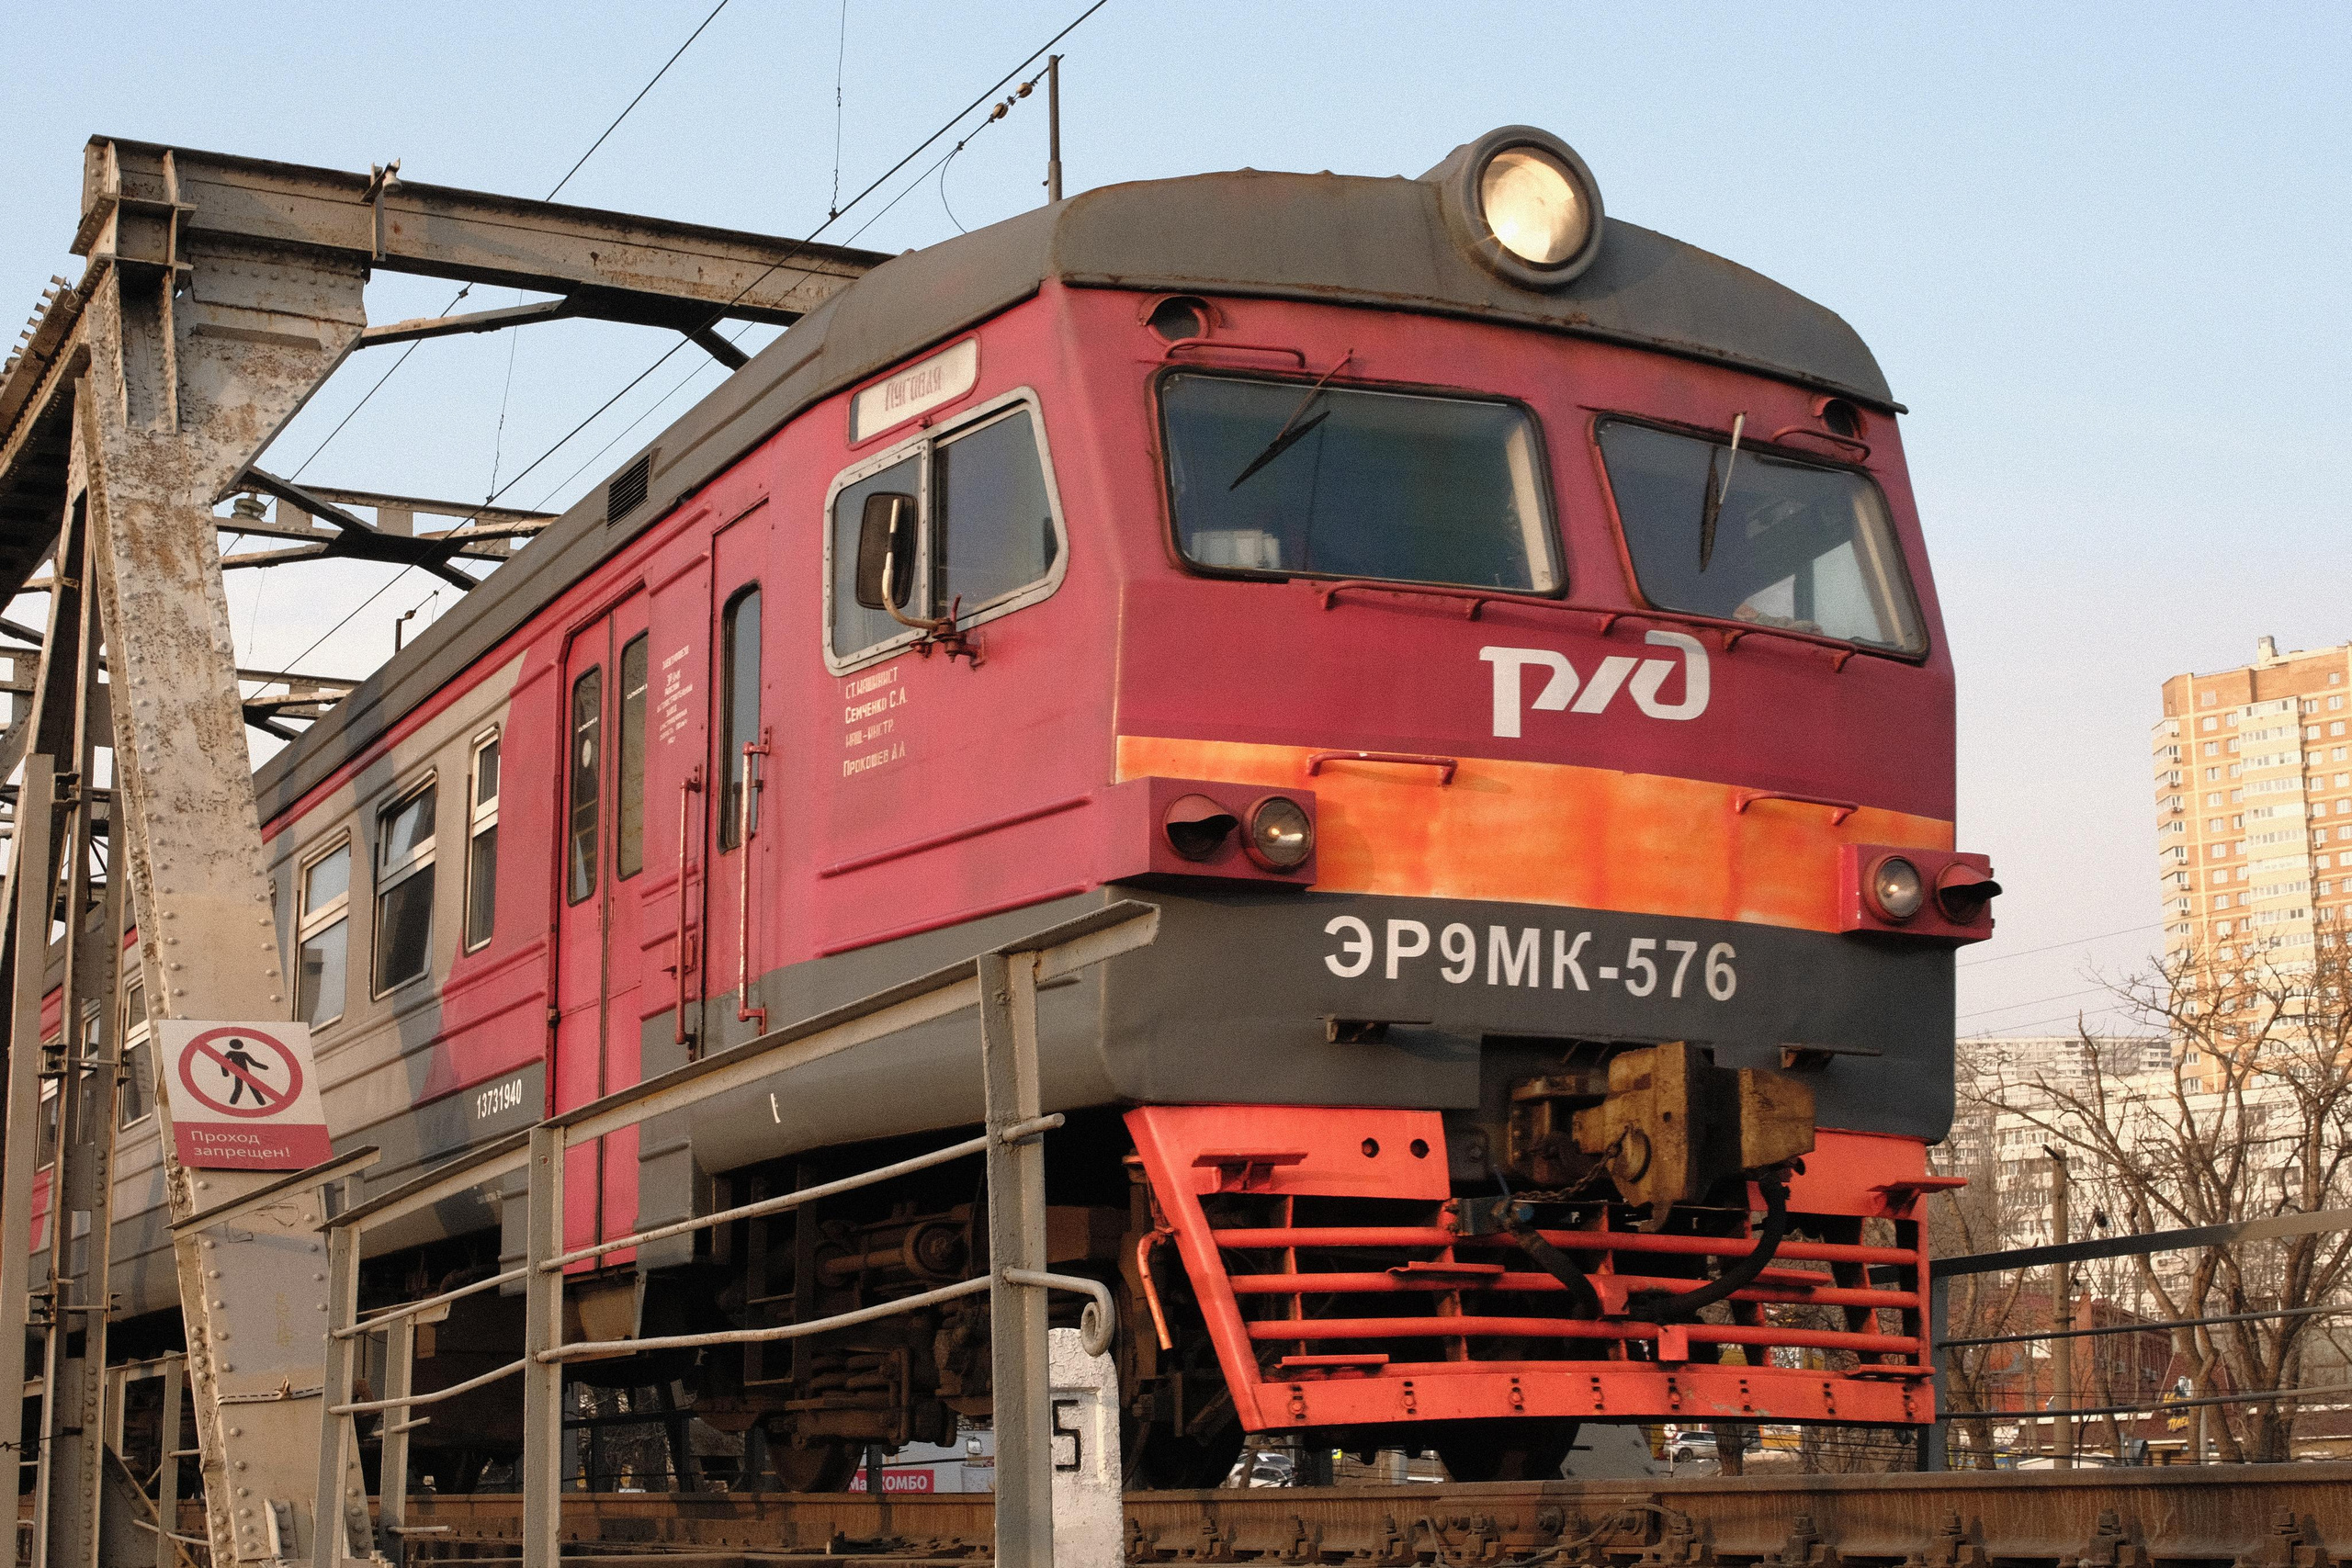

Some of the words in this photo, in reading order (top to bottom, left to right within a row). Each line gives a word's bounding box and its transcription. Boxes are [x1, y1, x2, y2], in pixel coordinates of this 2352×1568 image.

[1323, 915, 1738, 1002] ЭР9МК-576
[477, 1078, 522, 1119] 13731940
[191, 1131, 260, 1145] Проход
[194, 1147, 290, 1159] запрещен!
[1052, 1399, 1081, 1472] 5
